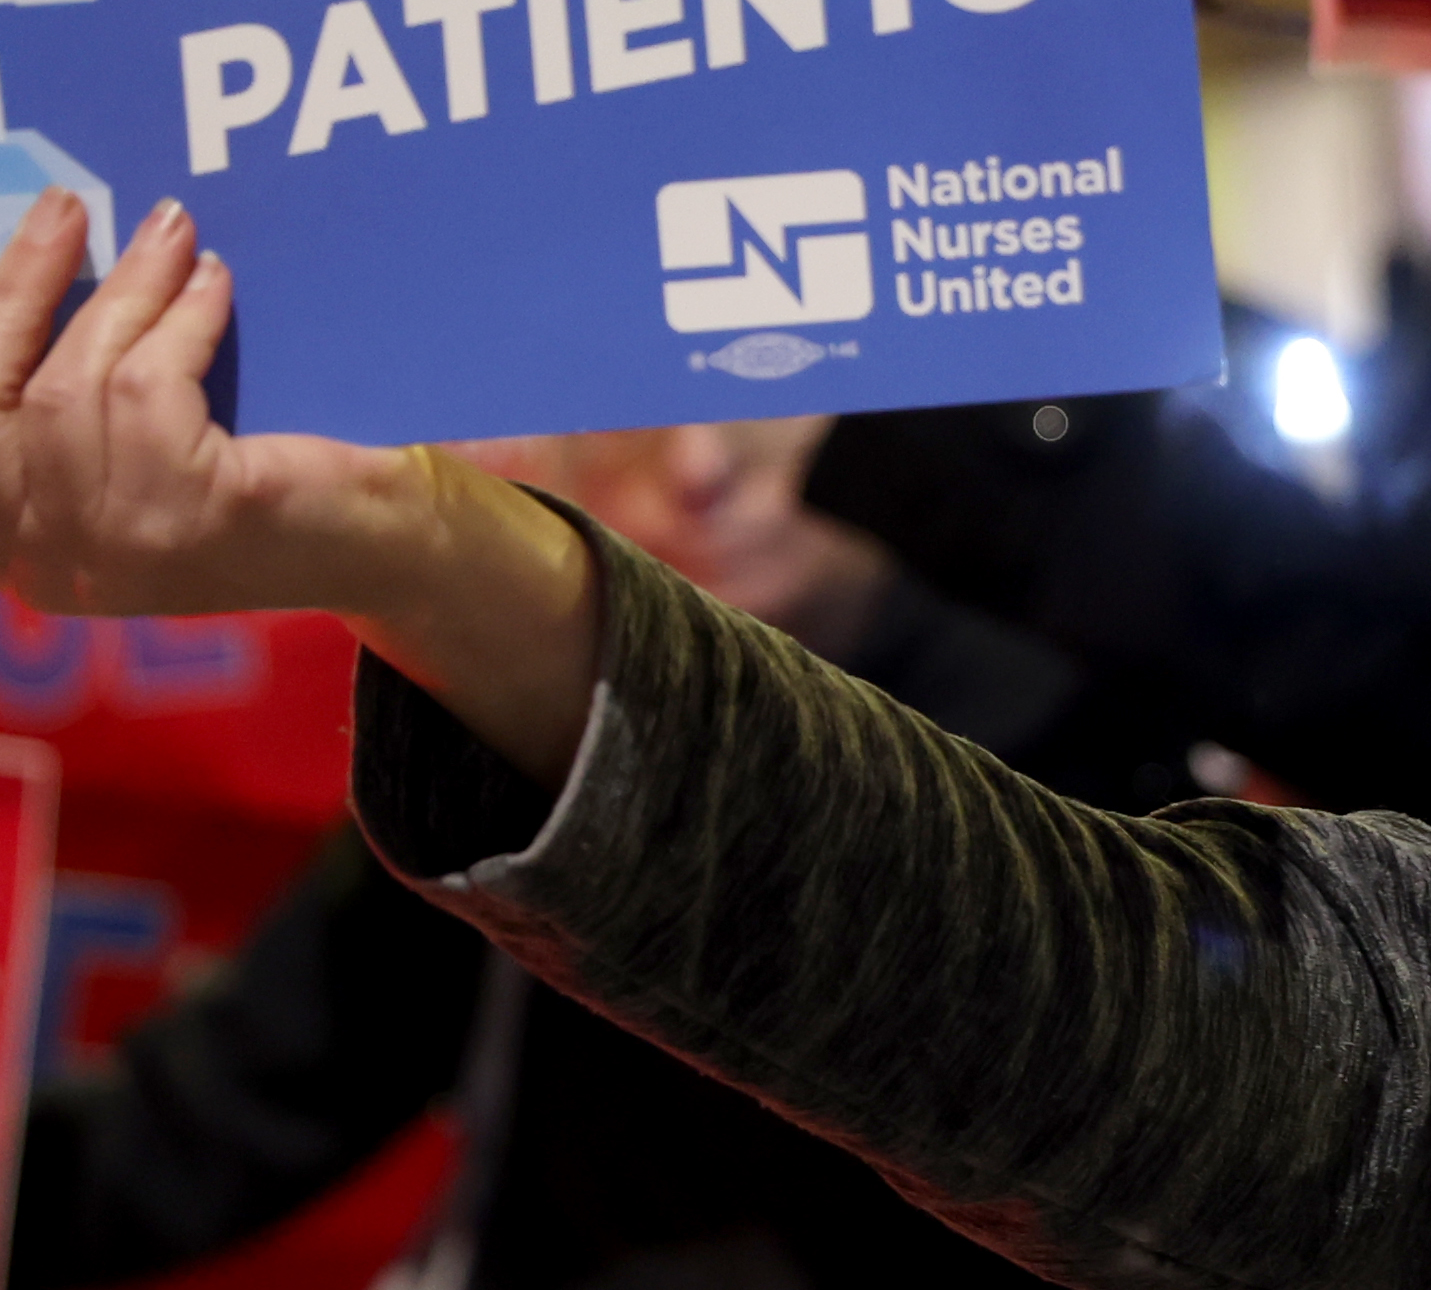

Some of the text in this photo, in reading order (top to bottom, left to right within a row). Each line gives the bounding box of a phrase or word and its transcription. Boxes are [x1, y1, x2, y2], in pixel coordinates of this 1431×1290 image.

[886, 146, 1124, 209] National
[891, 210, 1084, 263] Nurses
[894, 259, 1084, 317] United
